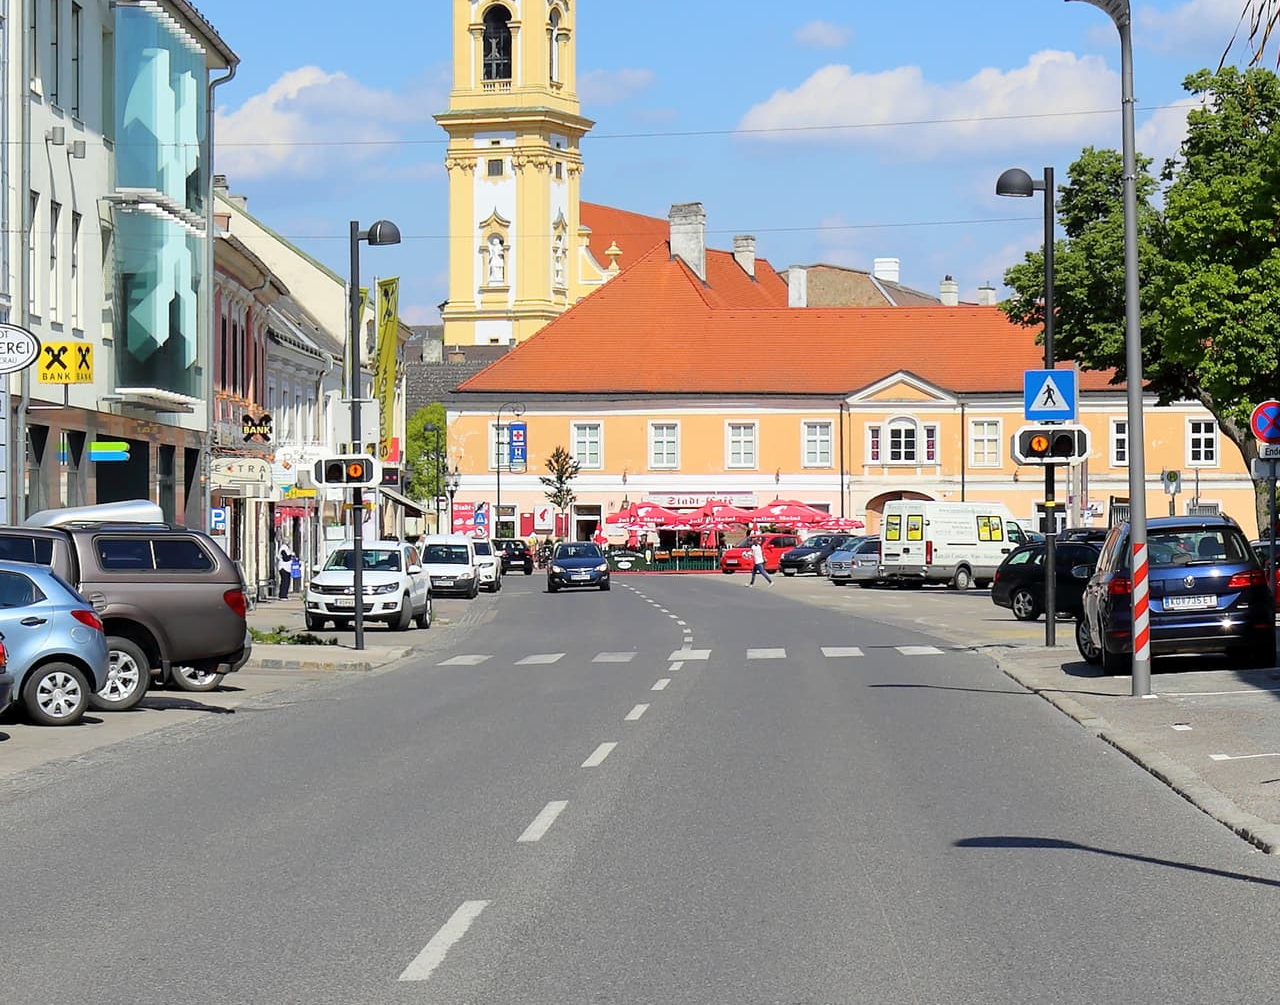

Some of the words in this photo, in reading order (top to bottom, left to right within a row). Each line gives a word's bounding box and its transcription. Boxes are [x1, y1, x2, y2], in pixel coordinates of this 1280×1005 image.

[41, 372, 71, 381] BANK
[76, 372, 92, 381] BANK
[243, 426, 271, 434] BANK
[211, 509, 225, 530] P
